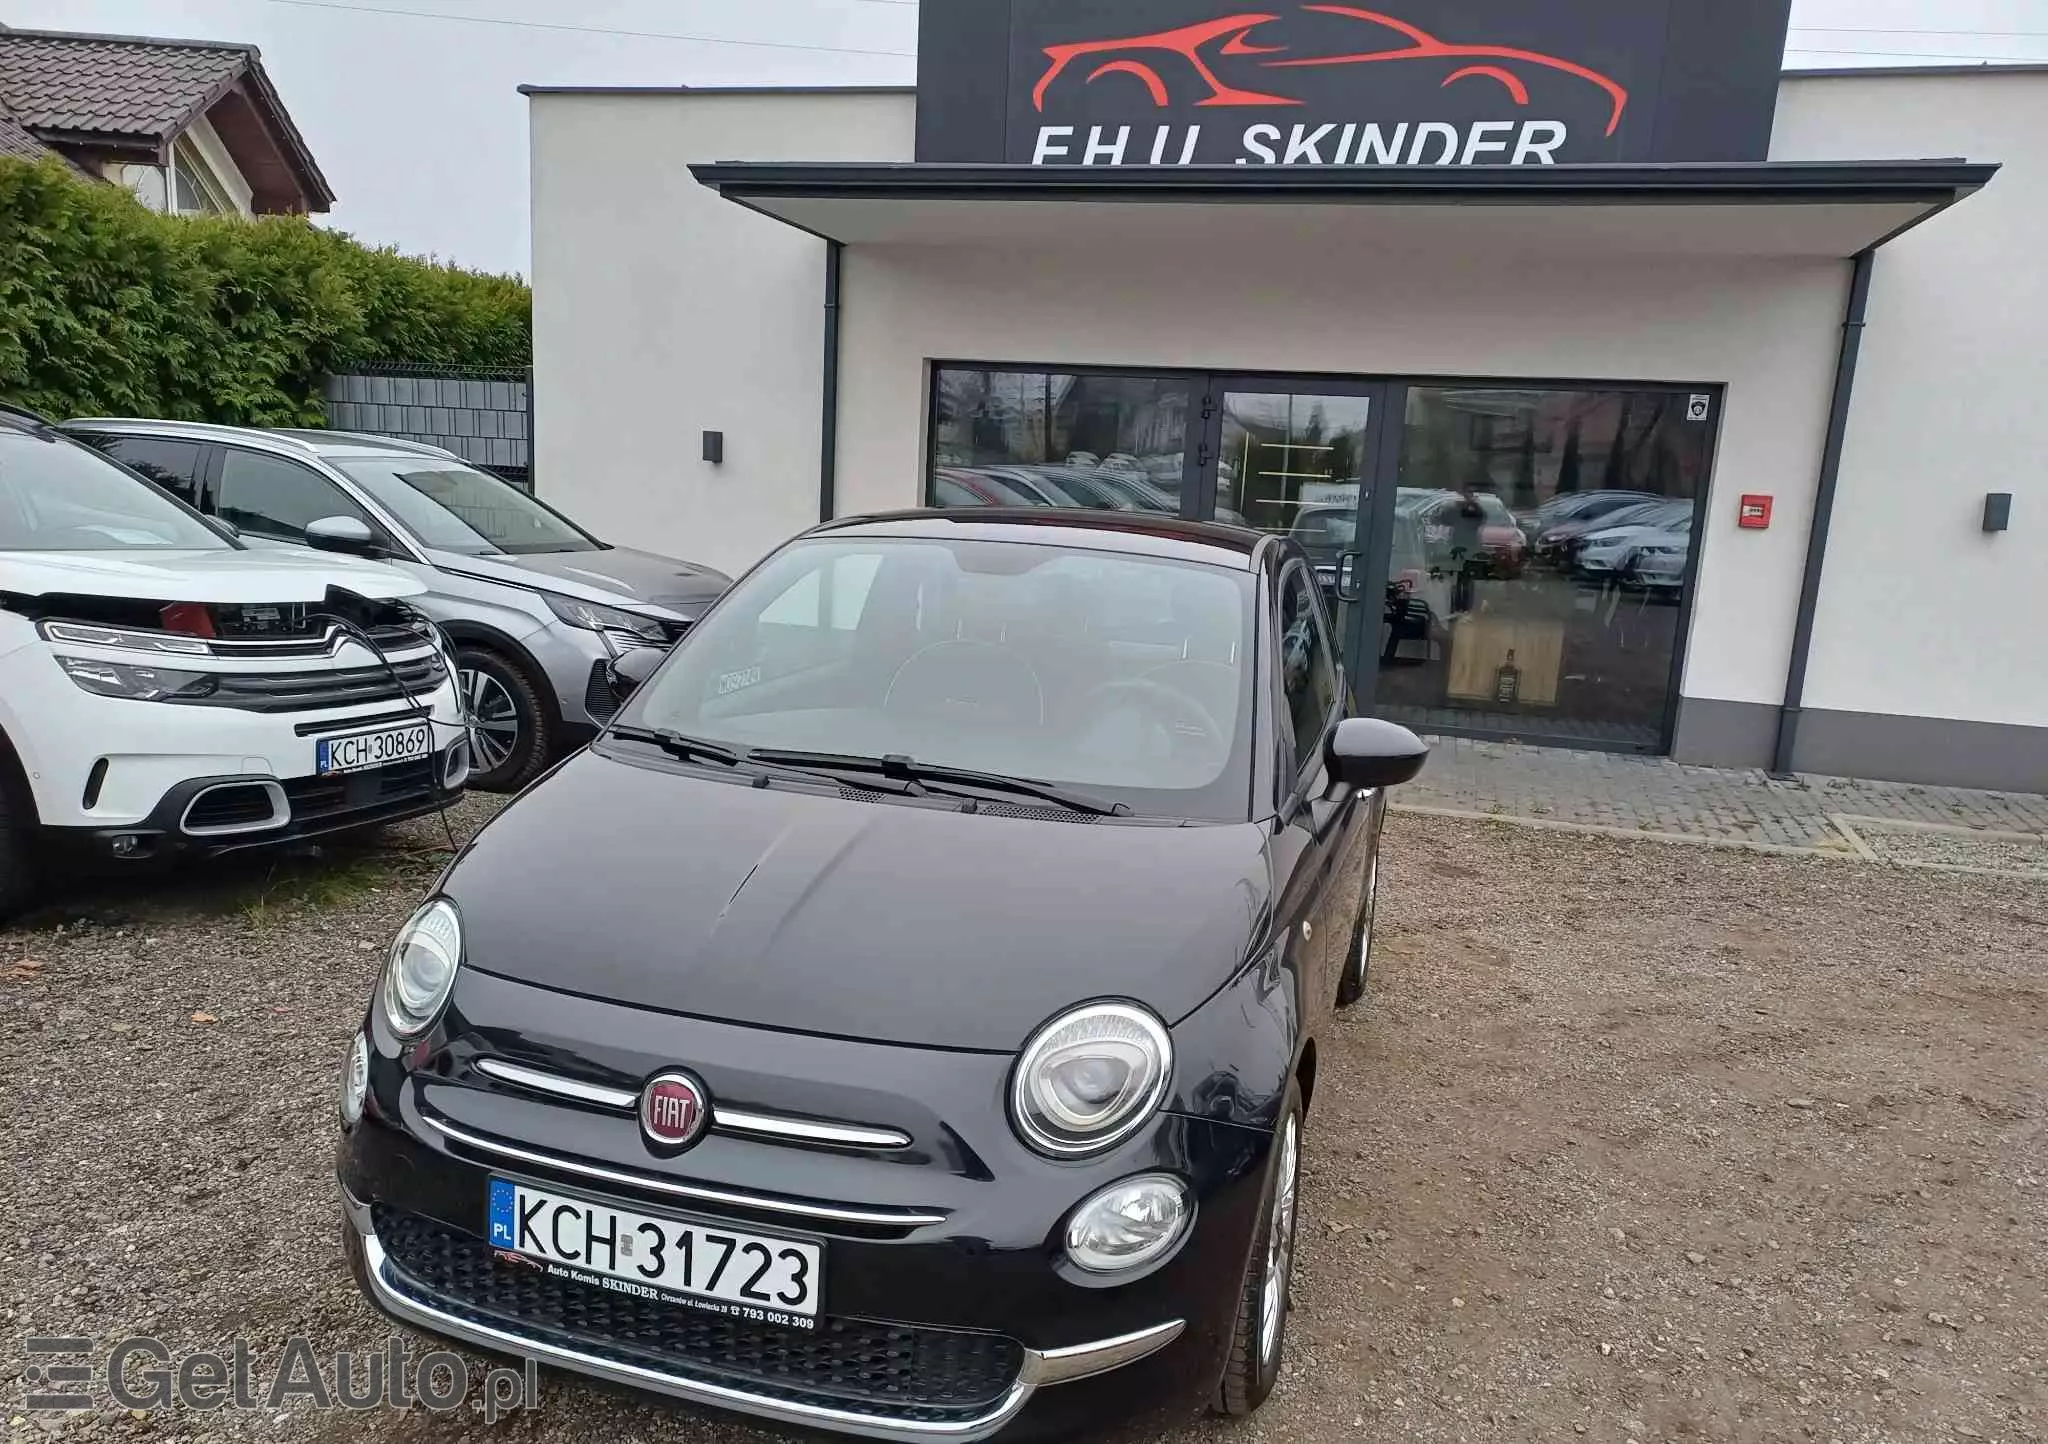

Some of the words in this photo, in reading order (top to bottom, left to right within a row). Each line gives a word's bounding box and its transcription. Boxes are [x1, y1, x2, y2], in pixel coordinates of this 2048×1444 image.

[653, 1095, 690, 1129] FIAT
[494, 1222, 511, 1240] PL
[547, 1263, 569, 1278] Auto
[602, 1277, 659, 1300] SKINDER
[743, 1307, 764, 1321] 793
[767, 1311, 789, 1325] 002
[792, 1316, 814, 1329] 309
